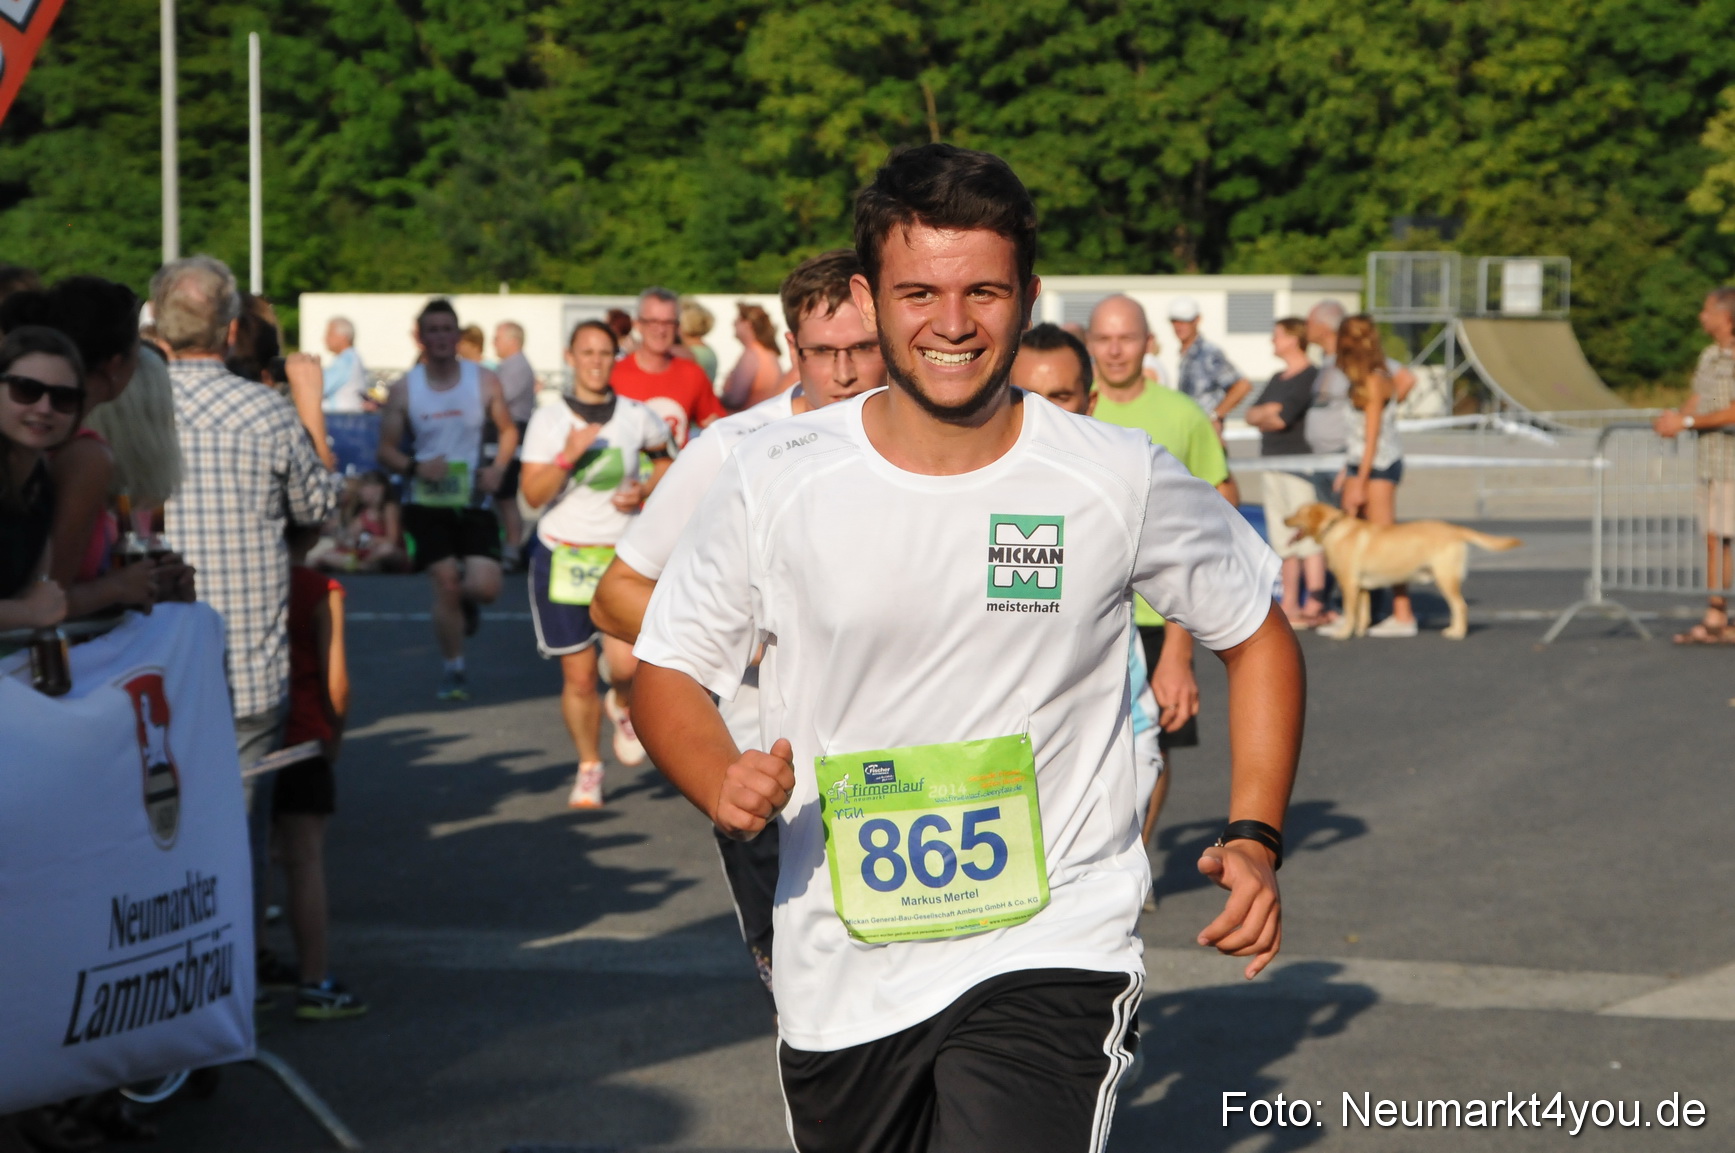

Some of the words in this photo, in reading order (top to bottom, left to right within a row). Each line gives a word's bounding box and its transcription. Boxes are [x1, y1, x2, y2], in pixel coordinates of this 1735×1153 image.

[785, 432, 818, 450] JAKO
[988, 547, 1064, 564] MICKAN
[986, 601, 1060, 613] meisterhaft
[852, 777, 925, 797] firmenlauf
[928, 782, 967, 798] 2014
[853, 795, 886, 803] neumarkt
[858, 806, 1008, 892] 865
[901, 896, 942, 906] Markus
[944, 888, 979, 903] Mertel
[108, 870, 218, 950] Neumarkter
[870, 911, 955, 923] General-Bau-Gesellschaft
[956, 906, 984, 916] Amberg
[984, 902, 1006, 911] GmbH
[1027, 896, 1039, 904] KG
[62, 930, 235, 1047] Lammsbräu
